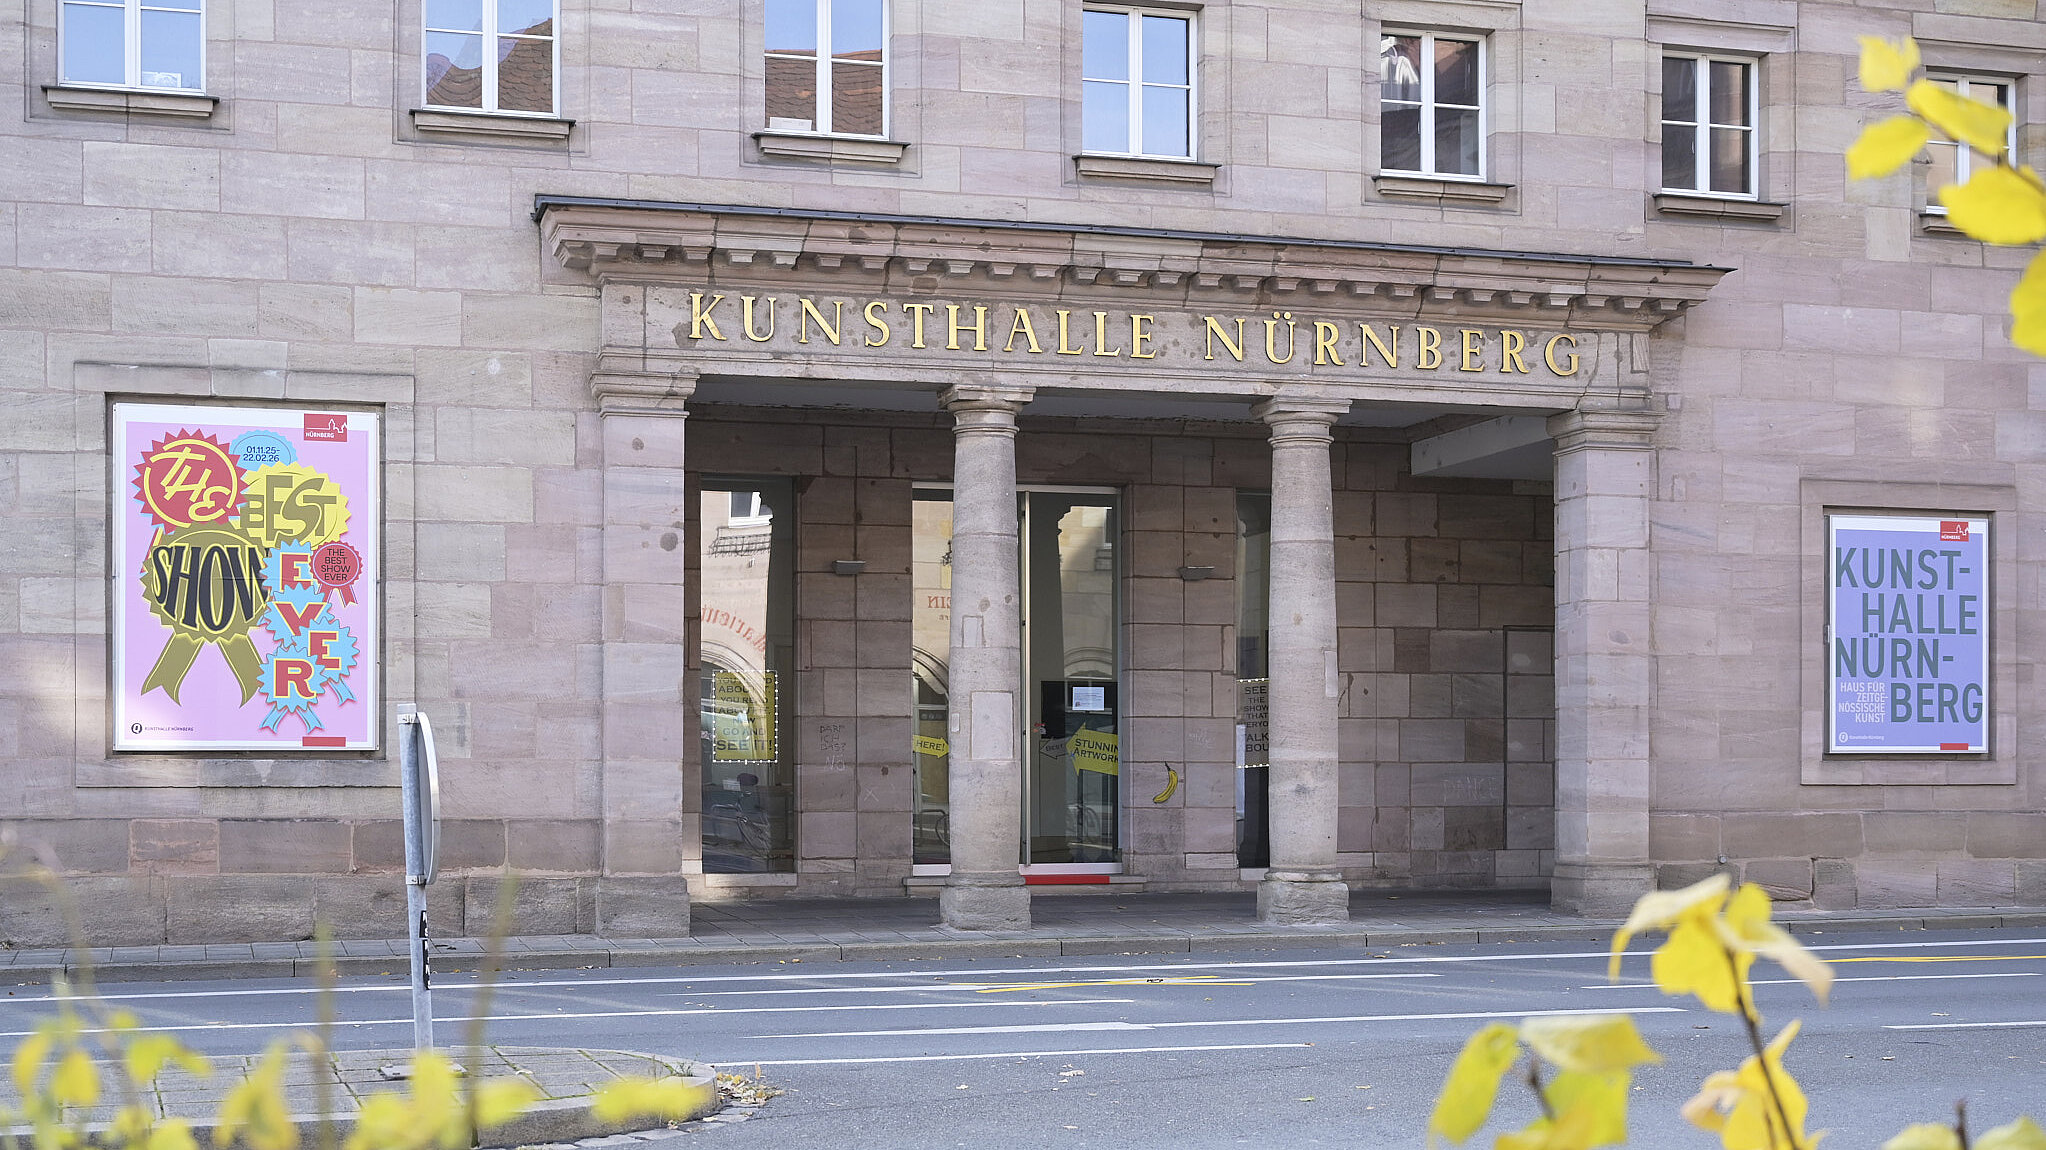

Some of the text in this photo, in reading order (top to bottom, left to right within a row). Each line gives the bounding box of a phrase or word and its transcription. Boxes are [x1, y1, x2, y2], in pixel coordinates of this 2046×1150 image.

[688, 292, 1580, 377] KUNSTHALLE NÜRNBERG
[305, 431, 335, 439] NÜRNBERG
[246, 446, 280, 454] 01.11.25-
[243, 454, 280, 462] 22.02.26
[151, 446, 231, 522] THE
[240, 475, 336, 547] BEST
[327, 548, 345, 556] THE
[1835, 547, 1970, 590] KUNST-
[152, 546, 269, 631] SHOW
[1862, 593, 1977, 635] HALLE
[1835, 633, 1954, 679] NÜRN-
[1245, 686, 1267, 694] SEE
[1840, 681, 1885, 692] HAUS FÜR
[1856, 692, 1888, 702] ZEITGE-
[1891, 682, 1983, 723] BERG
[1839, 701, 1885, 712] NÖSSISCHE
[1855, 713, 1885, 722] KUNST
[716, 740, 772, 751] SEE IT!
[916, 740, 945, 752] HERE!
